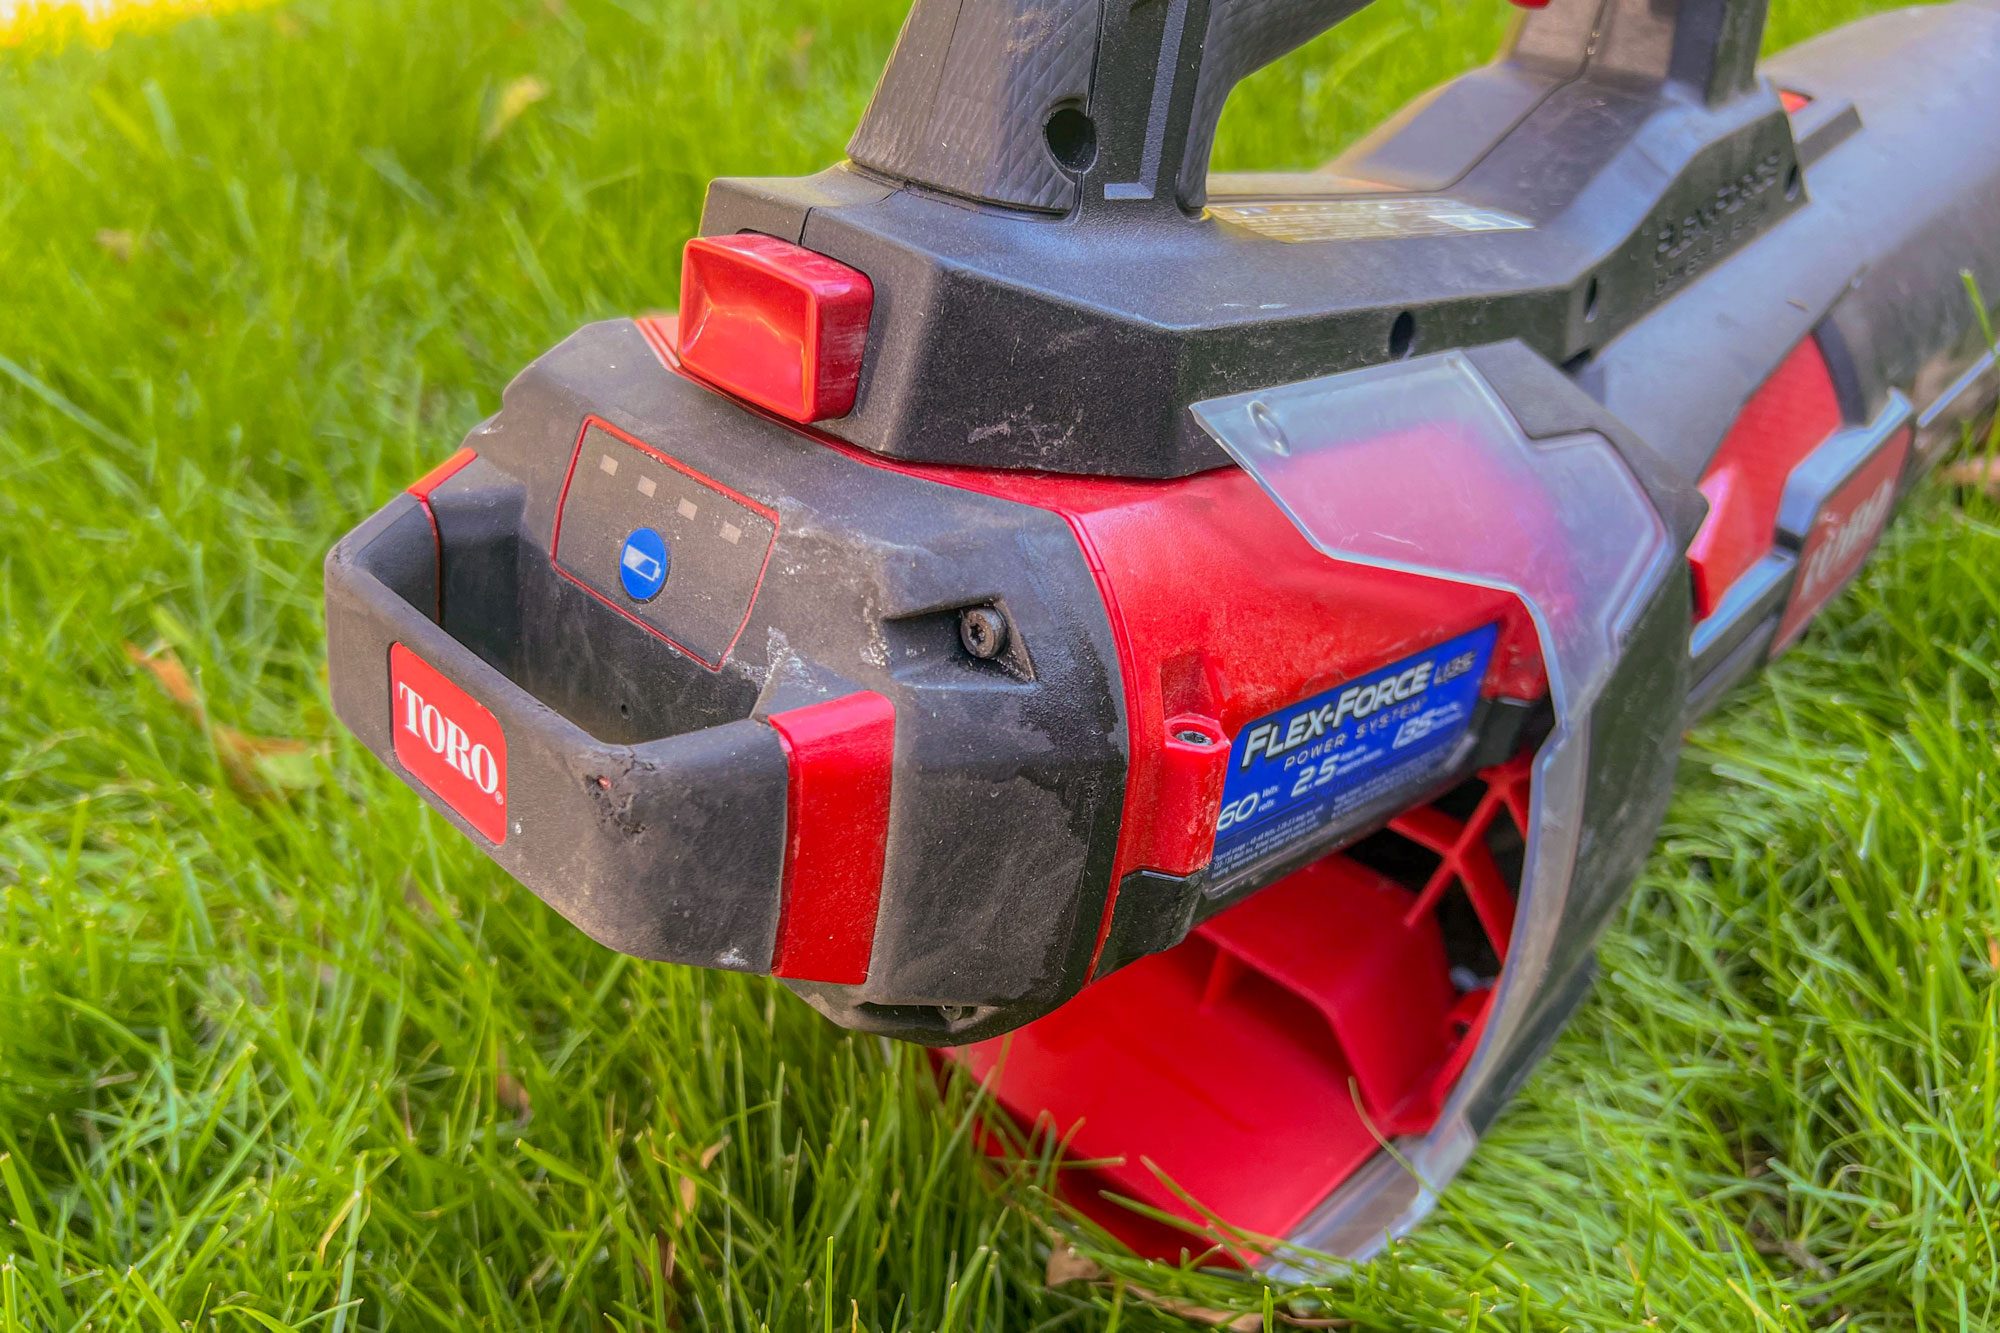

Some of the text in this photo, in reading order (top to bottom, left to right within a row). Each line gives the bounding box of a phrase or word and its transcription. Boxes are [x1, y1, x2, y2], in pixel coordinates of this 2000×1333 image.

[1241, 660, 1434, 769] FLEX-FORCE
[400, 681, 498, 794] TORO
[1284, 732, 1348, 771] POWER
[1291, 754, 1340, 798] 2.5
[1216, 791, 1260, 832] 60
